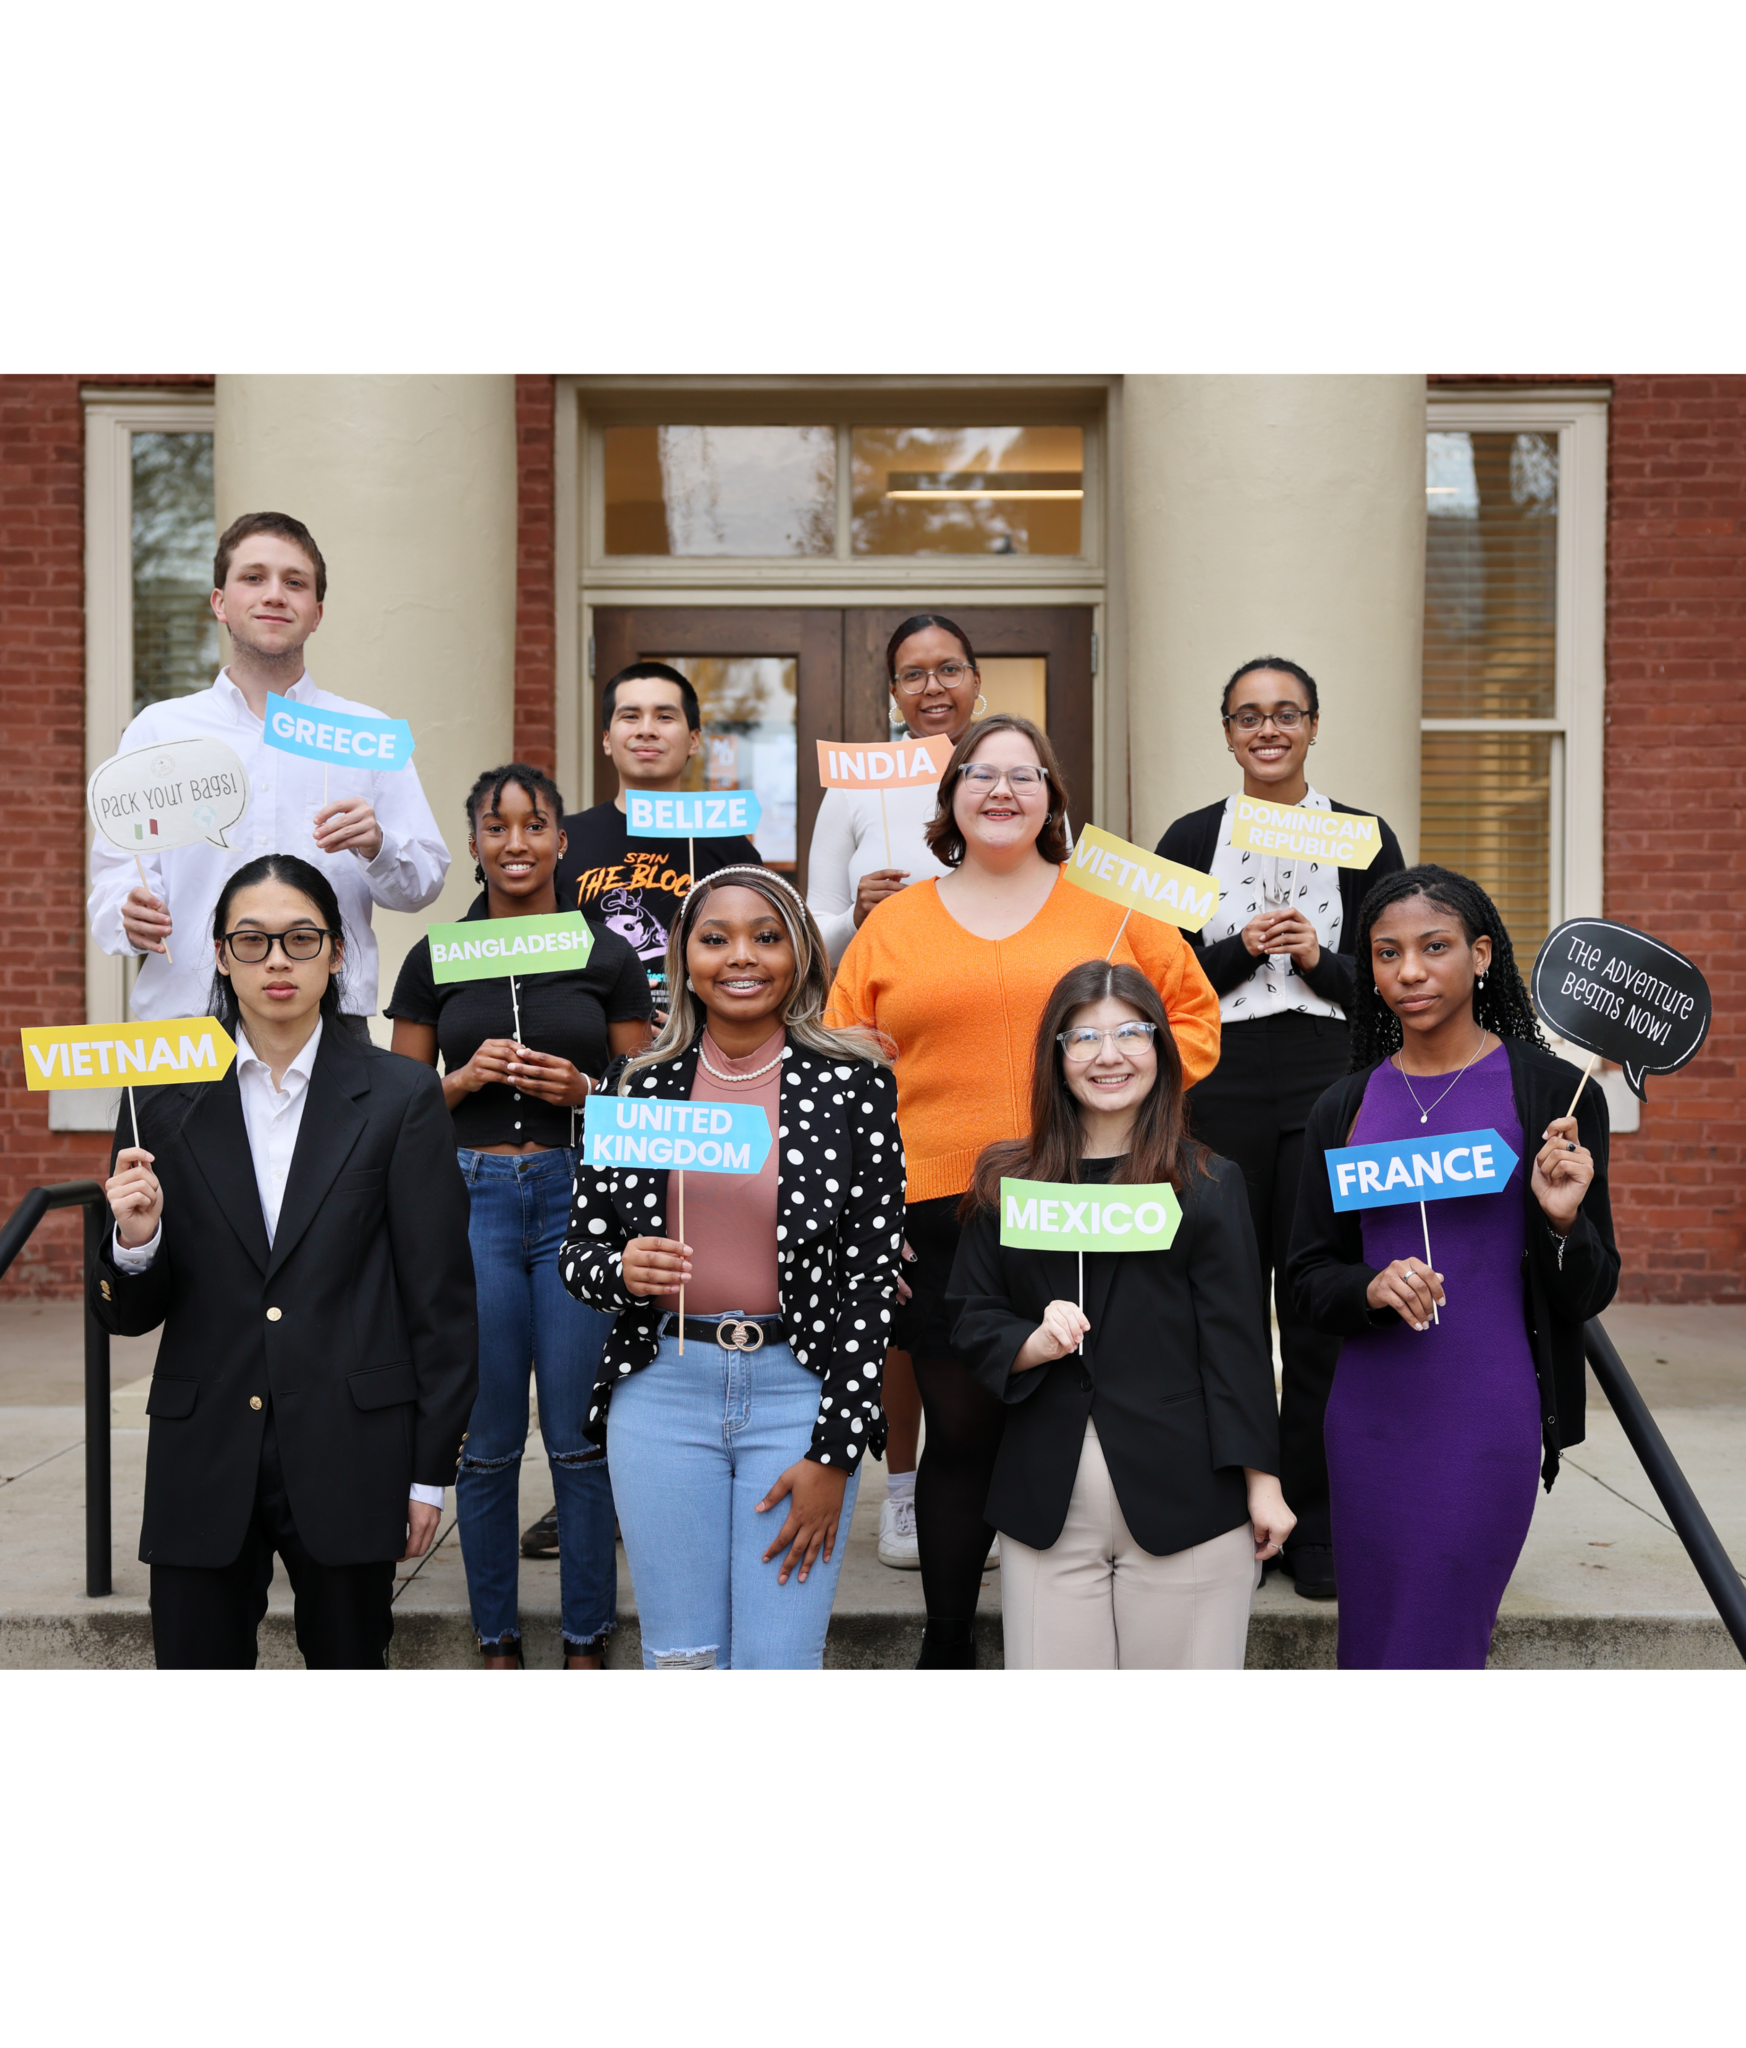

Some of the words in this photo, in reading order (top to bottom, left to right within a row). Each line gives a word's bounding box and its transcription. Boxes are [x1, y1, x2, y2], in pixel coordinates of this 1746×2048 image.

[272, 711, 397, 759] GREECE
[828, 747, 937, 781] INDIA
[631, 798, 747, 829] BELIZE
[1238, 801, 1373, 841] DOMINICAN
[623, 852, 670, 864] SPIN
[1248, 826, 1354, 860] REPUBLIC
[575, 865, 628, 908] THE
[623, 863, 698, 897] BLOC
[1074, 838, 1214, 918] VIETNAM
[432, 929, 588, 963] BANGLADESH
[1624, 1004, 1672, 1046] NOW!
[29, 1033, 218, 1078] VIETNAM
[616, 1102, 733, 1135] UNITED
[592, 1134, 750, 1169] KINGDOM
[1335, 1144, 1496, 1197] FRANCE
[1006, 1194, 1167, 1235] MEXICO
